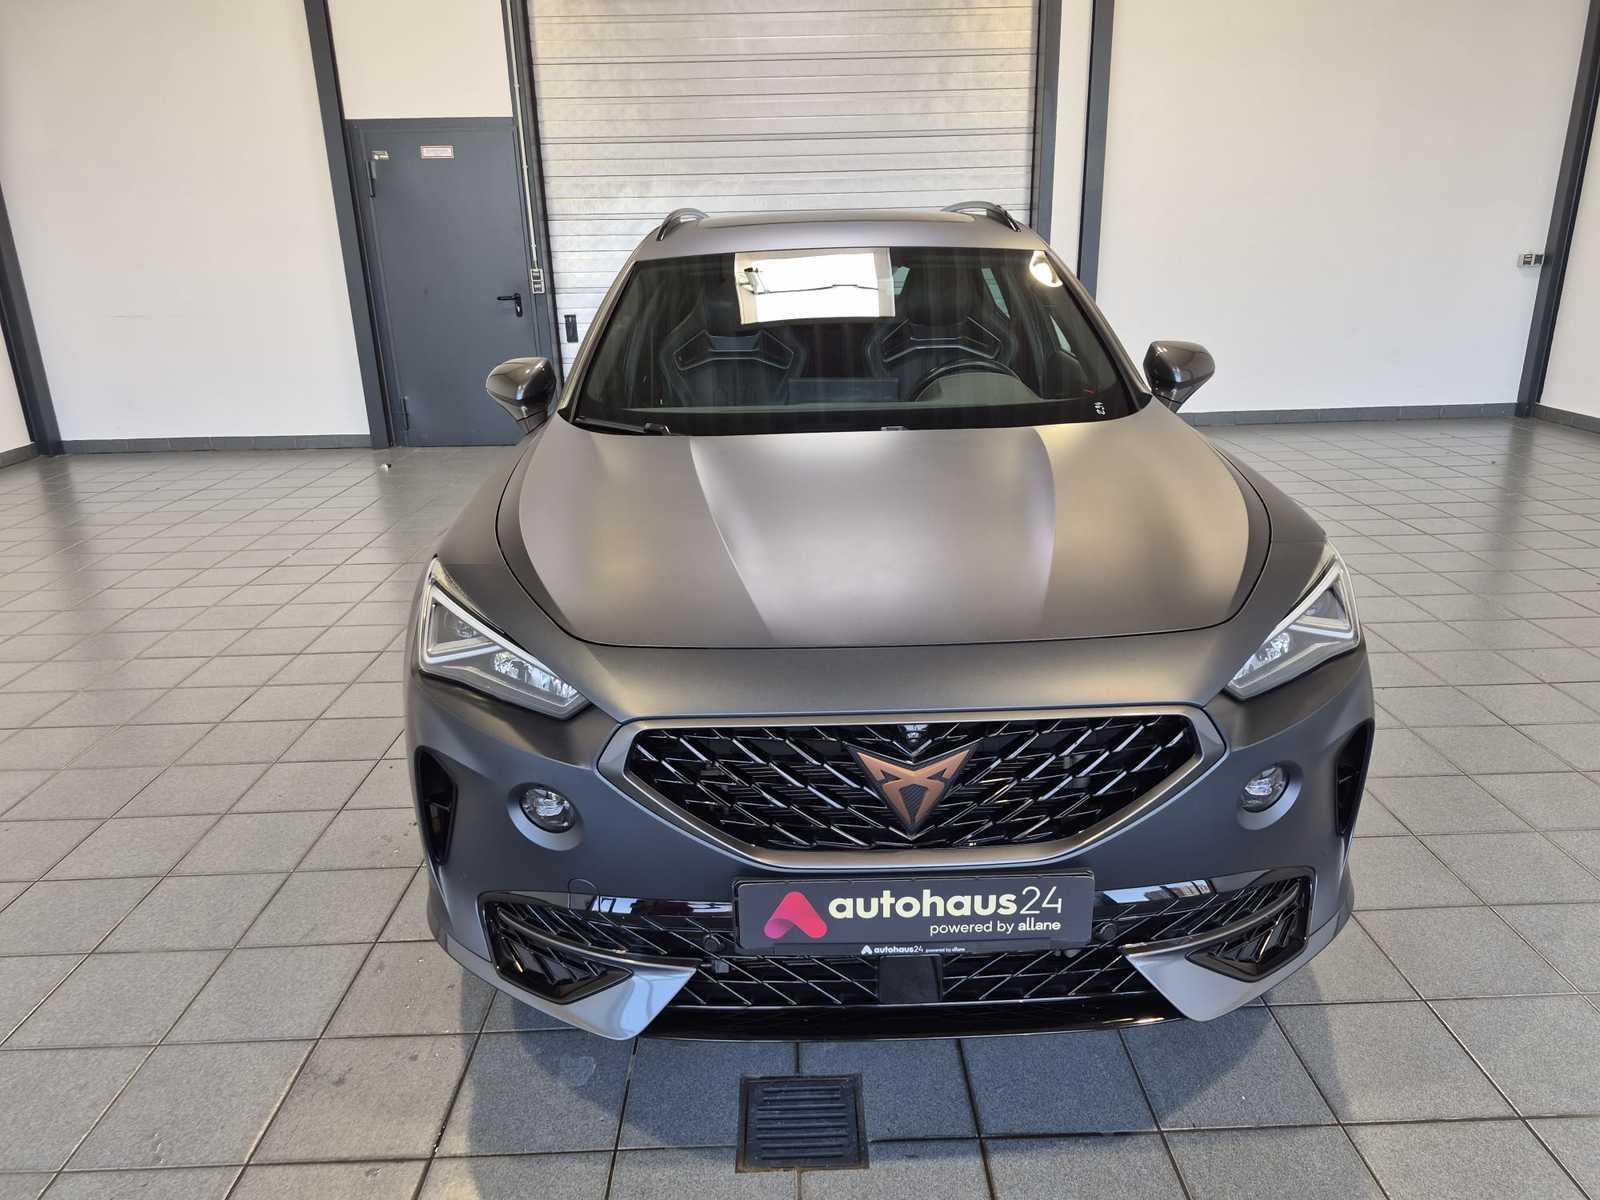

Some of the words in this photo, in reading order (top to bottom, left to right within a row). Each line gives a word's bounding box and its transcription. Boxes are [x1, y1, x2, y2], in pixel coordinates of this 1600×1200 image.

[828, 886, 1062, 919] autohaus24
[930, 921, 993, 936] powered
[997, 919, 1014, 935] by
[1018, 917, 1061, 931] allane
[874, 945, 923, 954] autohaus24
